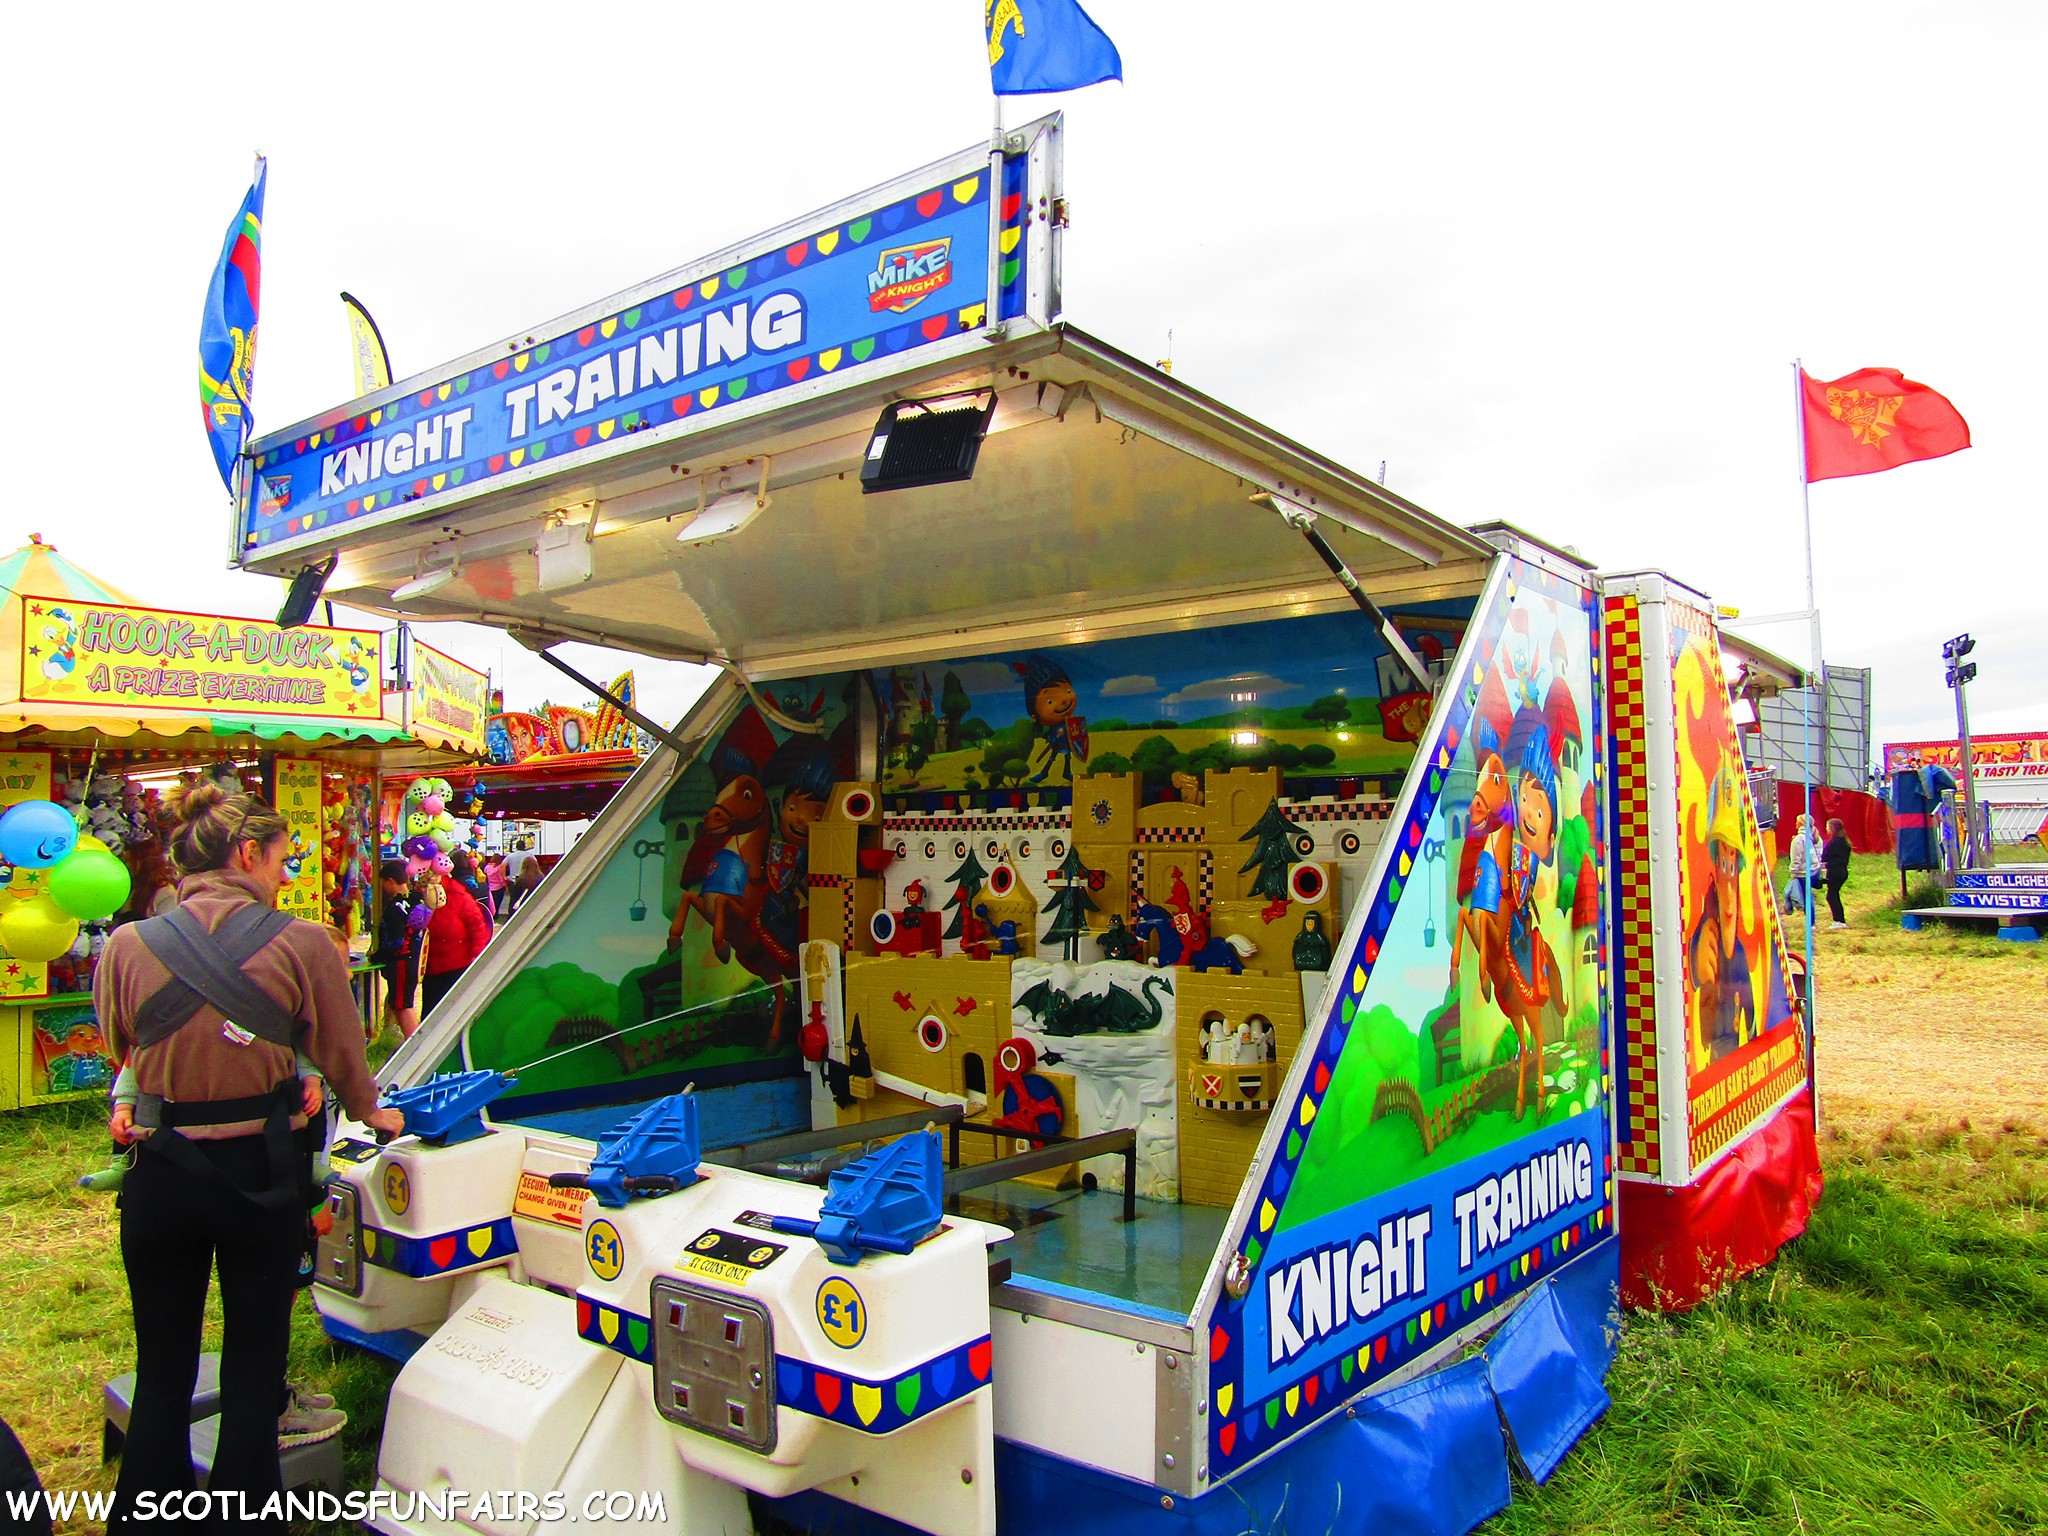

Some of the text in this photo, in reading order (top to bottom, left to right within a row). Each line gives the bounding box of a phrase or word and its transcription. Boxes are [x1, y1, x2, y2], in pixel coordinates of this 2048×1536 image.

[887, 272, 945, 298] KNIGHT
[320, 293, 802, 498] KNIGHT TRAINING
[80, 610, 334, 670] HOOK-A-DUCK
[86, 664, 326, 705] A PRIZE EVERYTIME
[1388, 702, 1411, 720] THE
[279, 772, 317, 788] HOOK
[1984, 765, 2020, 778] TASTY
[293, 791, 304, 806] A
[294, 889, 305, 904] A
[1967, 894, 2041, 907] TWISTER
[281, 907, 320, 920] RIZE
[1692, 1079, 1727, 1129] FIREMAN
[387, 1174, 409, 1203] £1
[556, 1187, 590, 1202] CAMERAS
[519, 1191, 545, 1205] CHANGE
[547, 1198, 567, 1210] GIVEN
[569, 1203, 577, 1212] AT
[590, 1234, 618, 1267] £1
[1268, 1142, 1592, 1364] KNIGHT TRAINING
[689, 1256, 752, 1281] £1 COINS ONLY
[823, 1293, 859, 1334] £1
